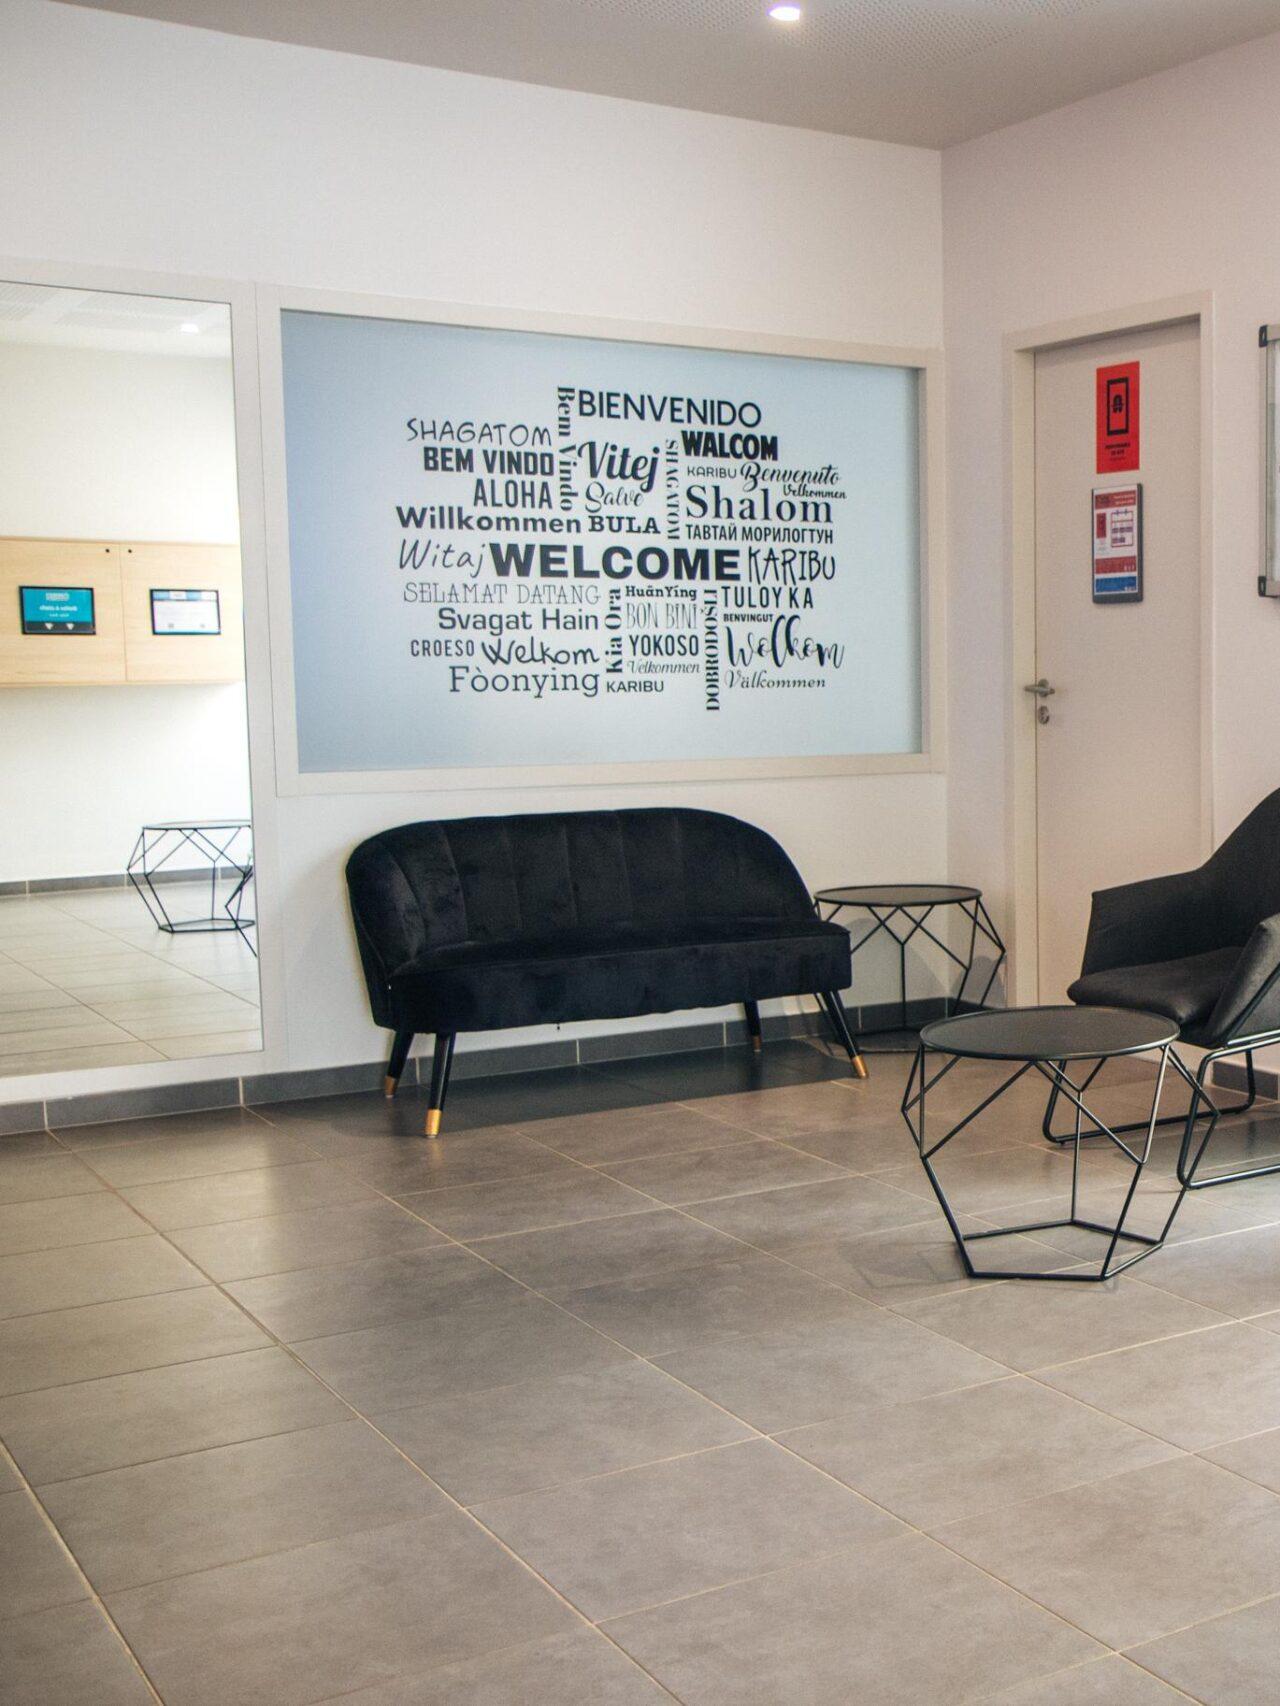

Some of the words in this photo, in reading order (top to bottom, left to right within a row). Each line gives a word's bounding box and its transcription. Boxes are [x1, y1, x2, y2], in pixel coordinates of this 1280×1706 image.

[557, 386, 575, 437] Bem
[578, 389, 762, 428] BIENVENIDO
[406, 417, 552, 446] SHAGATOM
[681, 430, 778, 461] WALCOM
[423, 446, 475, 473] BEM
[483, 449, 555, 476] VINDO
[577, 441, 660, 493] Vitej
[687, 465, 737, 479] KARIBU
[558, 444, 578, 511] Vindo
[665, 439, 680, 540] SHAGATOM
[740, 461, 841, 492] Benvenuto
[782, 483, 847, 499] Velkommen
[473, 478, 553, 510] ALOHA
[585, 481, 644, 513] Salve
[686, 484, 834, 523] Shalom
[396, 506, 581, 534] Willkommen
[588, 515, 661, 534] BULA
[399, 539, 485, 578] Witaj
[489, 542, 741, 581] WELCOME
[748, 546, 836, 586] KARIBU
[404, 582, 507, 604] SELAMAT
[517, 584, 601, 605] DATANG
[721, 586, 782, 608] TULOY
[789, 587, 814, 609] KA
[438, 607, 532, 637] Svagat
[542, 608, 599, 630] Hain
[604, 588, 621, 630] Ora
[626, 602, 658, 629] BON
[723, 613, 773, 622] BENVINGUT
[410, 639, 475, 657] CROESO
[481, 636, 600, 665] Welkom
[605, 637, 622, 673] Kia
[629, 634, 699, 656] YOKOSO
[627, 660, 701, 674] Velkommen
[606, 681, 665, 692] KARIBU
